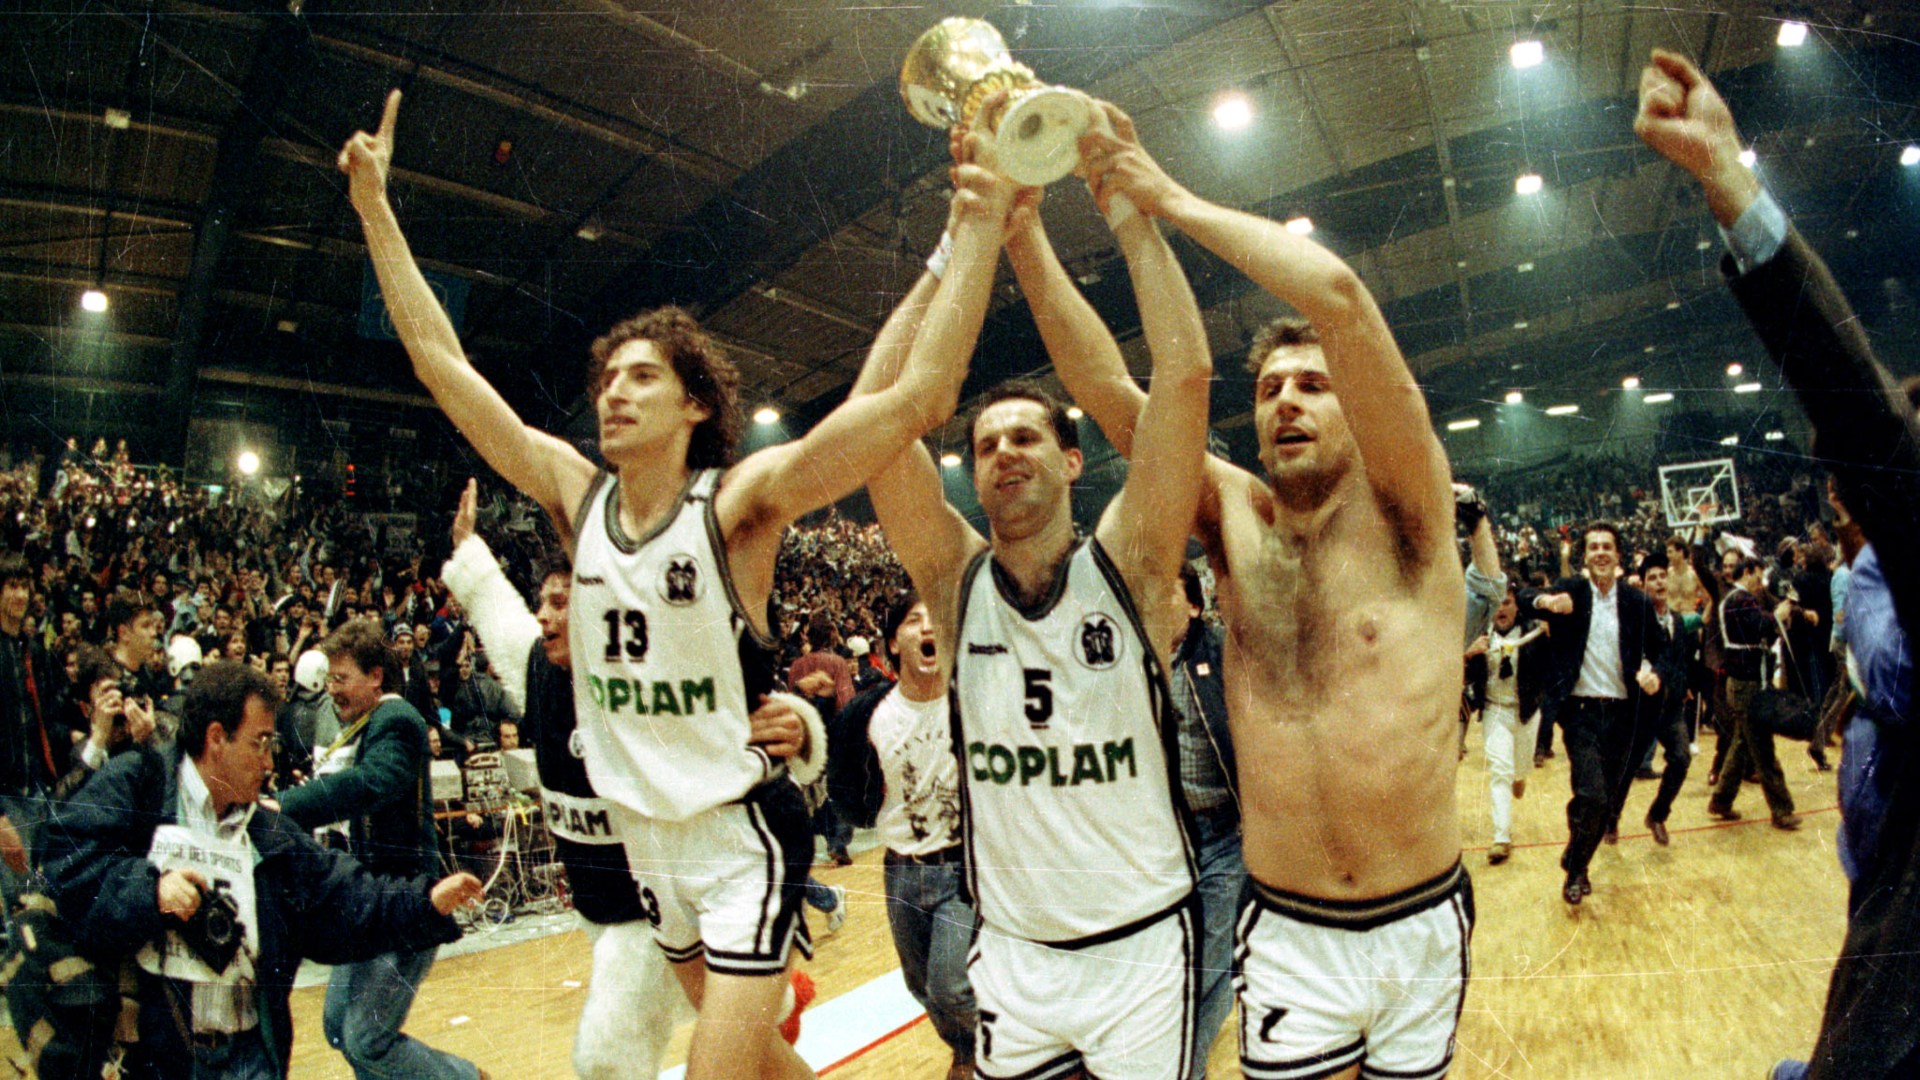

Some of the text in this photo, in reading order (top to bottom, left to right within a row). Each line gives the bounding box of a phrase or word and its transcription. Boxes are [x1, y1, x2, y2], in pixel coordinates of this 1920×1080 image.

[604, 609, 649, 663] 13
[1023, 668, 1053, 723] 5
[969, 737, 1137, 786] COPLAM
